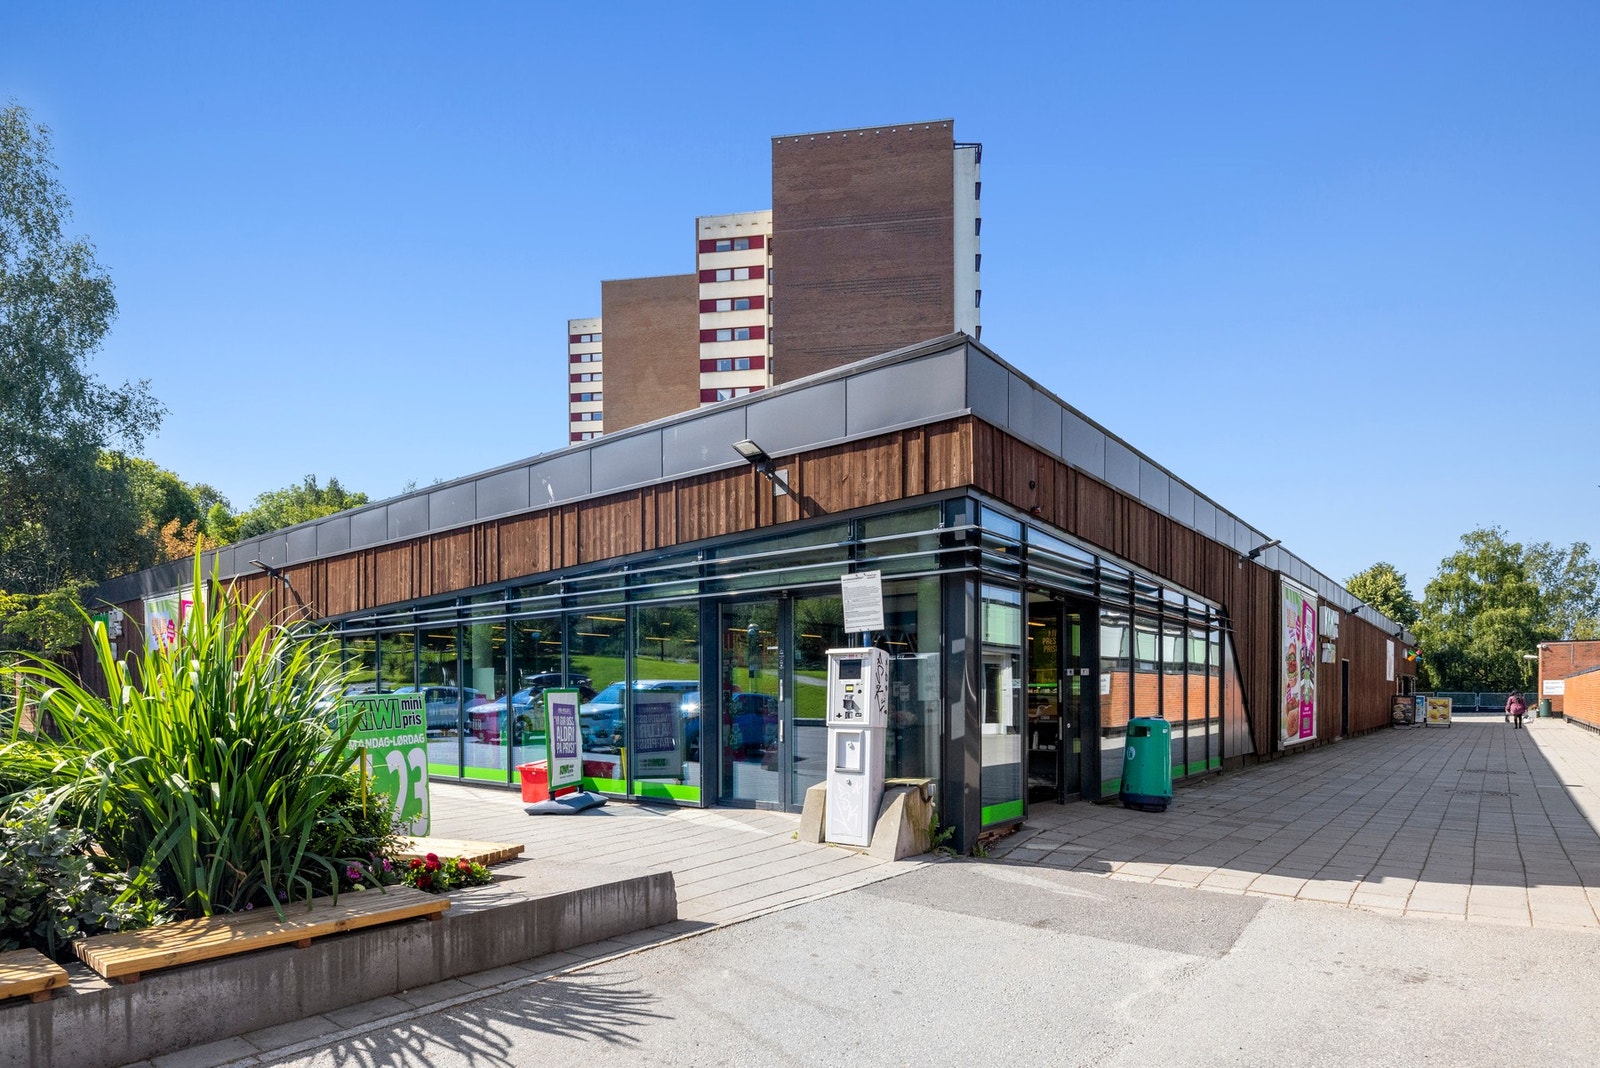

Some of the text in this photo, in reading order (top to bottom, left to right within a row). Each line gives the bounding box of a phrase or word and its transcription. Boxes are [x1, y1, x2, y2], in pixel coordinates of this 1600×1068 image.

[401, 695, 423, 711] mini
[345, 698, 402, 732] KIWI
[402, 712, 422, 729] pris
[349, 733, 425, 750] MANDAG-LØRDAG
[556, 726, 575, 742] ALDRI
